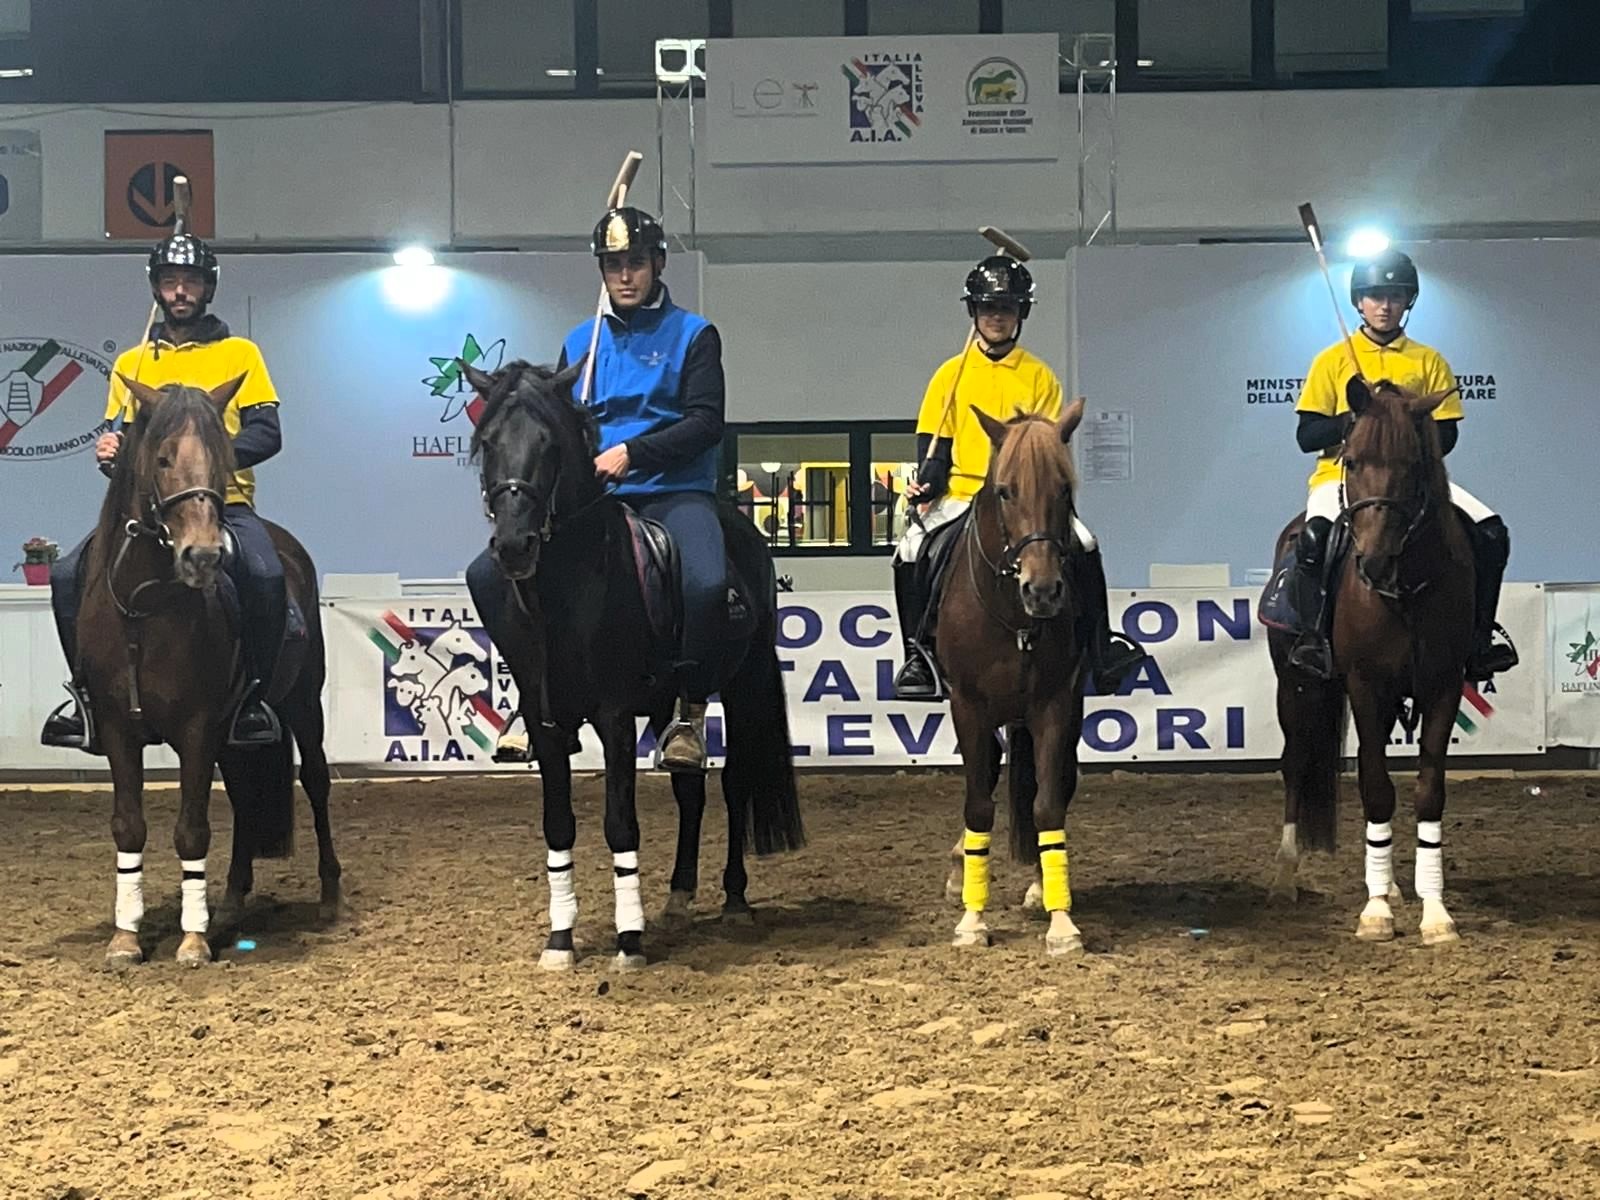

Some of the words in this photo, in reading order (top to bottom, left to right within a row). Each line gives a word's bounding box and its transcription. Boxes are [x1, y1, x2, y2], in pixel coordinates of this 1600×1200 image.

[864, 52, 922, 62] ITALIA
[850, 129, 902, 142] A.I.A.
[60, 346, 112, 381] ALLEVATO
[1247, 378, 1306, 390] MINIST
[1454, 374, 1496, 386] TURA
[1247, 392, 1294, 404] DELLA
[1459, 387, 1497, 400] TARE
[36, 438, 79, 456] ITALIANO
[80, 433, 95, 446] DA
[408, 608, 474, 622] ITAL
[384, 739, 475, 762] A.I.A.
